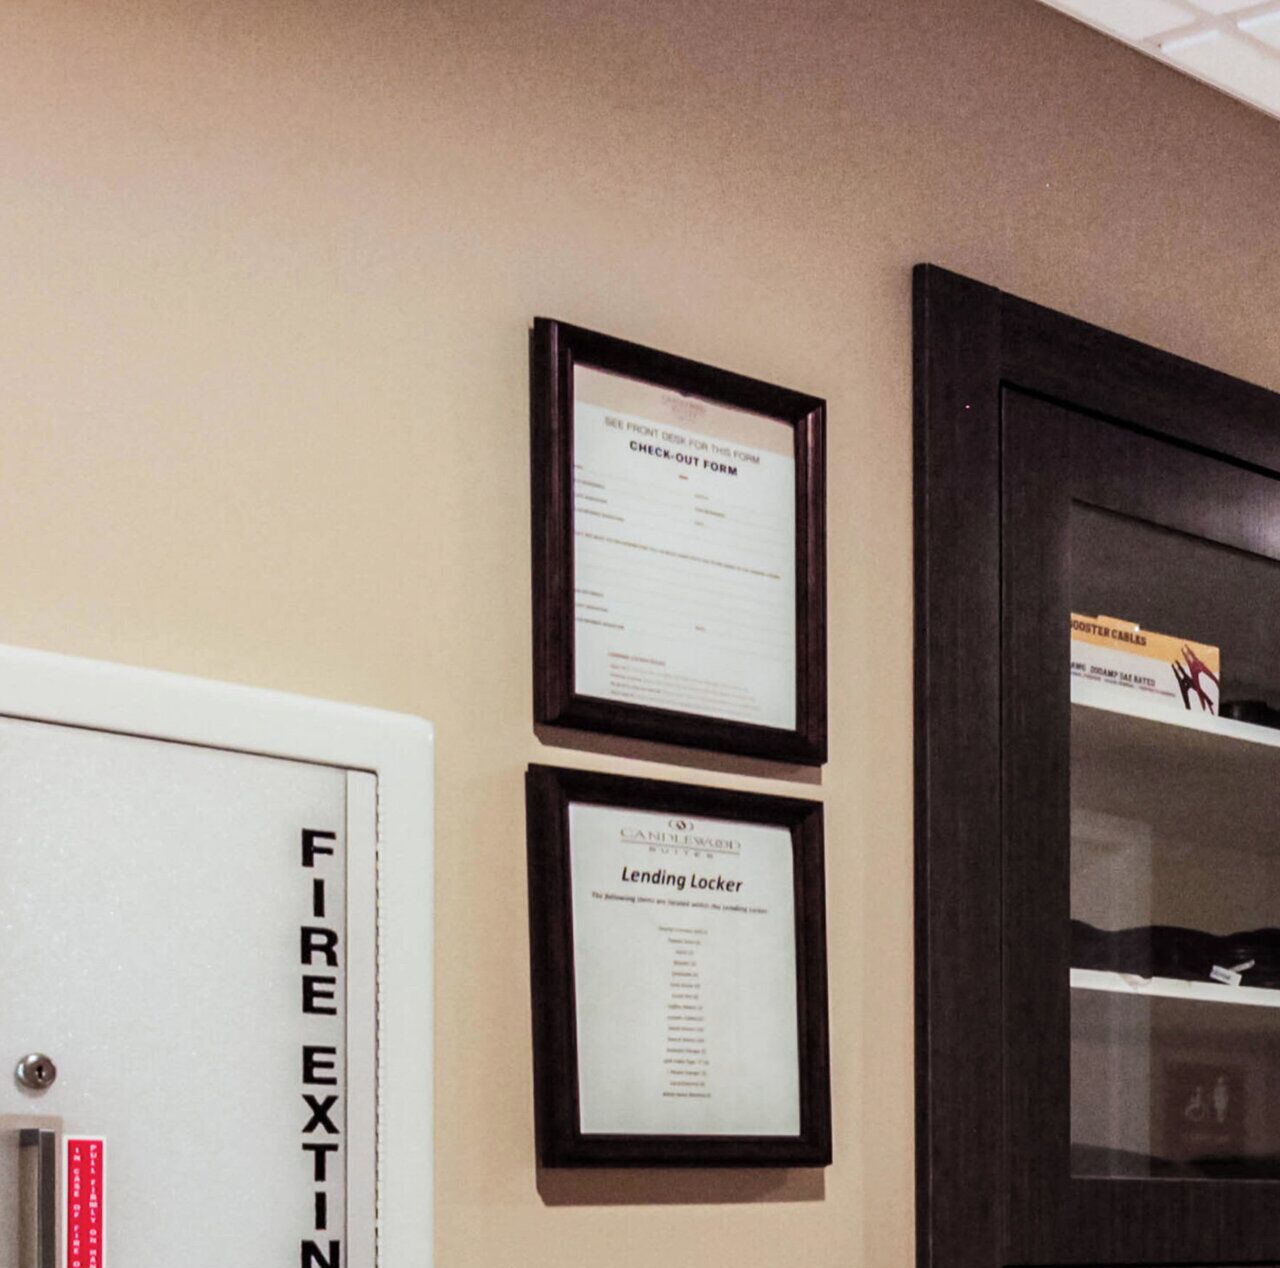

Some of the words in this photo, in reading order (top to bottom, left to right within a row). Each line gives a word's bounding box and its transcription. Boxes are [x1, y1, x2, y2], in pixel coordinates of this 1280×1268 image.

[605, 416, 623, 430] SEE
[626, 422, 659, 440] FRONT
[661, 431, 685, 445] DESK
[688, 439, 708, 450] FOR
[711, 444, 731, 457] THIS
[733, 451, 760, 465] FORM
[629, 440, 699, 467] CHECK-OUT
[703, 459, 738, 476] FORM
[1071, 620, 1110, 637] OOSTER
[1111, 628, 1147, 646] CABLES
[620, 829, 742, 850] CANDLEWOOD
[621, 866, 687, 891] Lending
[690, 873, 744, 893] Locker
[301, 828, 340, 1016] FIRE
